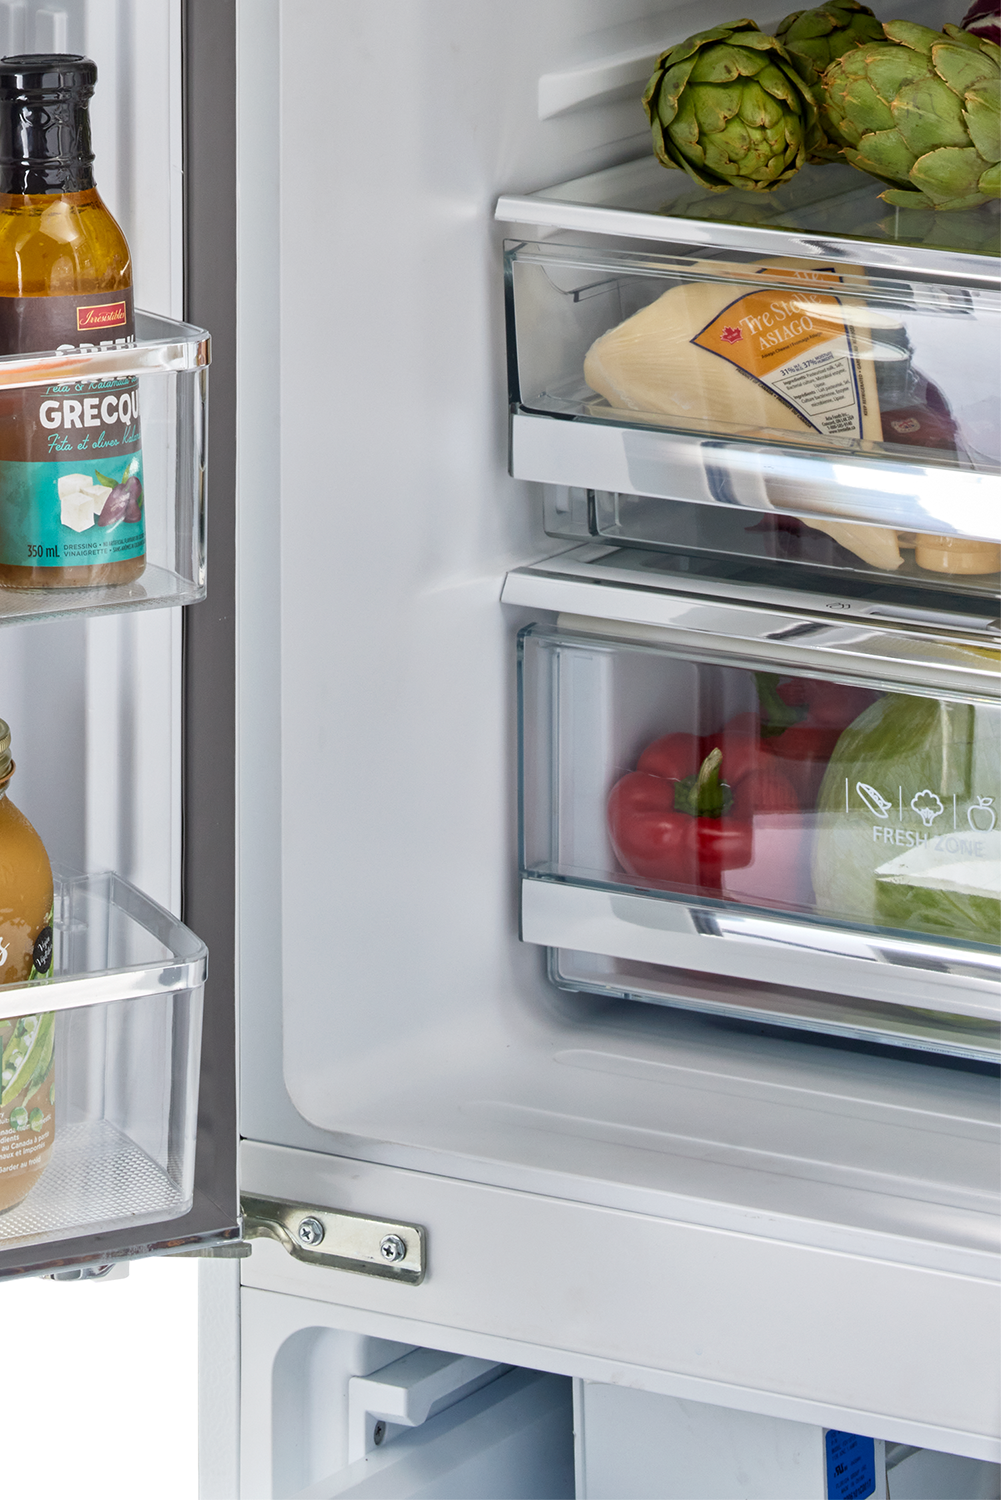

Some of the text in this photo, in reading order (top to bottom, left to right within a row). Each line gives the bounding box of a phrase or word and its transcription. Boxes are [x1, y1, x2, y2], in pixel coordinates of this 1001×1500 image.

[739, 311, 770, 336] Tre
[759, 315, 813, 351] ASIAGO
[39, 390, 140, 429] GRECQU
[77, 431, 120, 450] et olives
[27, 545, 44, 558] 350
[45, 545, 59, 558] mL
[63, 542, 97, 550] DRESSING
[63, 548, 108, 557] VINAIGRETTE
[873, 826, 984, 858] FRESH ZONE
